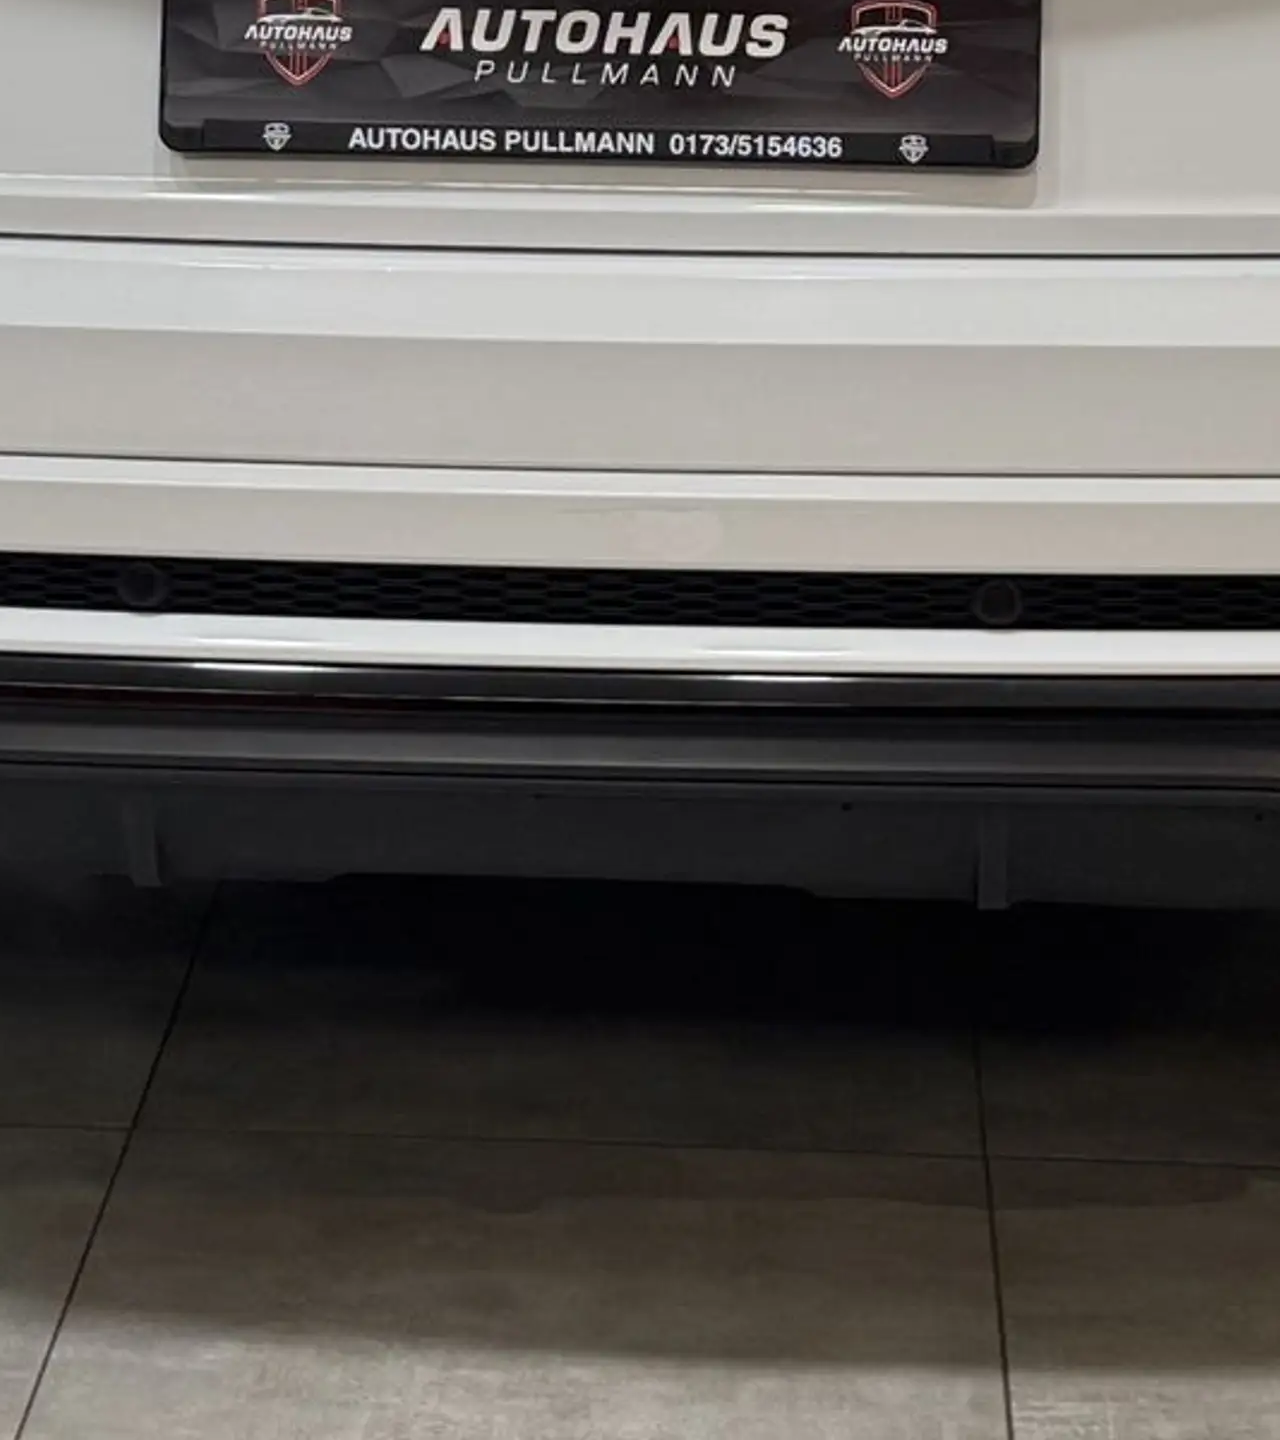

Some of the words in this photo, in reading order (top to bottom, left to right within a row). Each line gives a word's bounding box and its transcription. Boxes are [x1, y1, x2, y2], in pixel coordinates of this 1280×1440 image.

[243, 24, 353, 42] AUTOHAUS
[420, 7, 789, 58] AUTOHAUS
[837, 35, 949, 54] AUTOHAUS
[473, 60, 737, 88] PULLMANN
[348, 127, 497, 152] AUTOHAUS
[505, 130, 655, 154] PULLMANN
[669, 133, 844, 158] 0173/5154636
